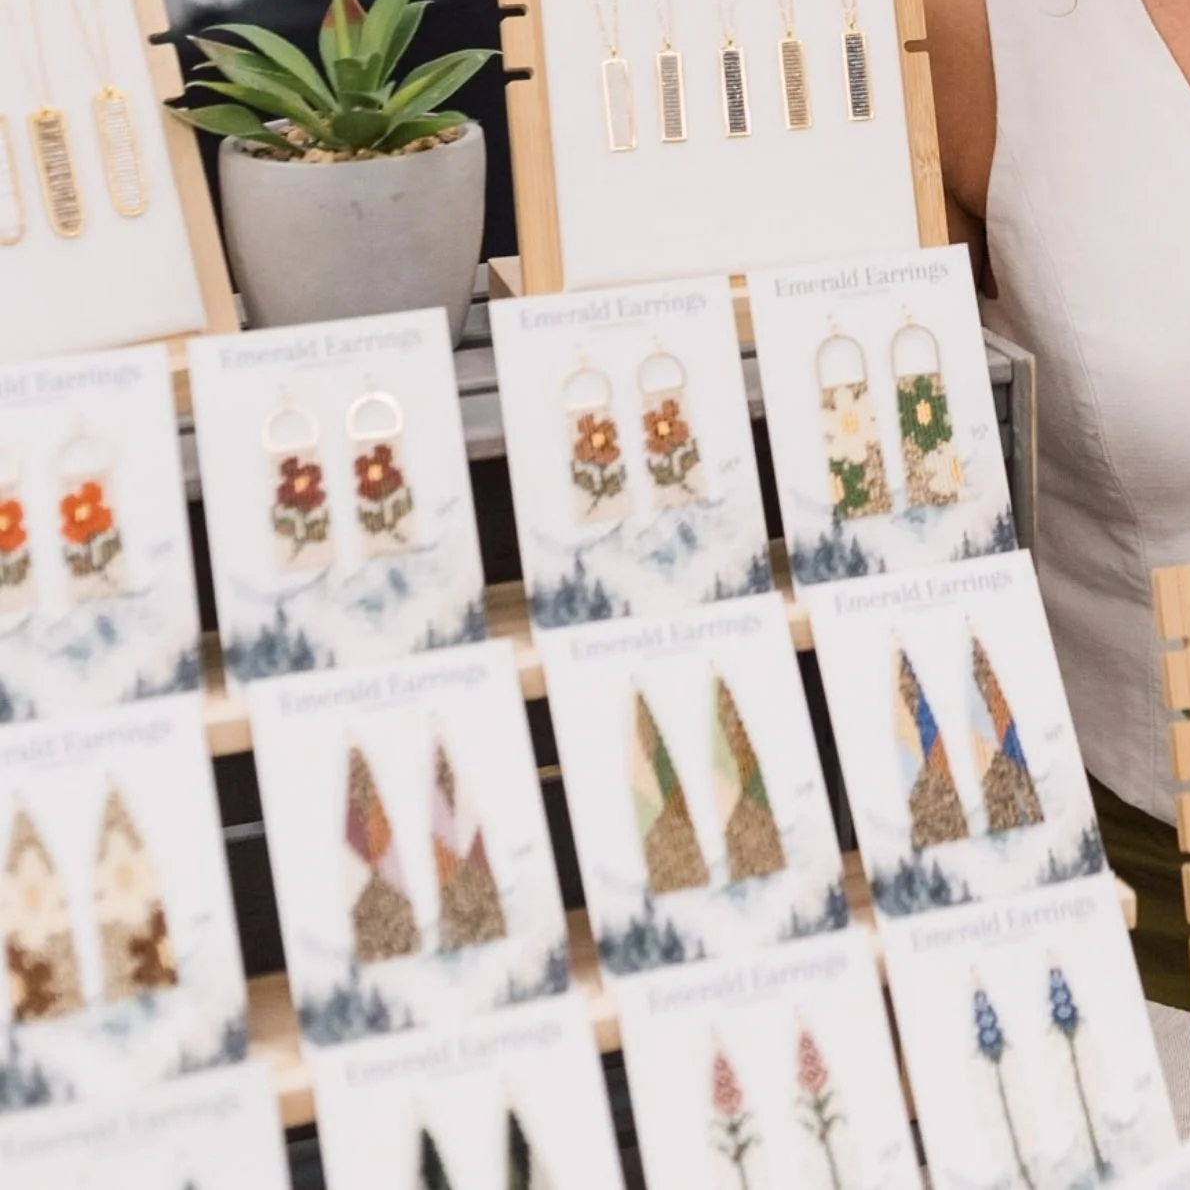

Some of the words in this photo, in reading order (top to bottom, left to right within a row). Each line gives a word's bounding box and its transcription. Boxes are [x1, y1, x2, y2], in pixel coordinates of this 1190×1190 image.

[774, 267, 858, 298] Emerald
[865, 262, 949, 290] Earrings
[519, 299, 610, 331] Emerald
[618, 289, 708, 318] Earrings
[834, 583, 920, 616] Emerald
[925, 567, 1013, 599] Earrings
